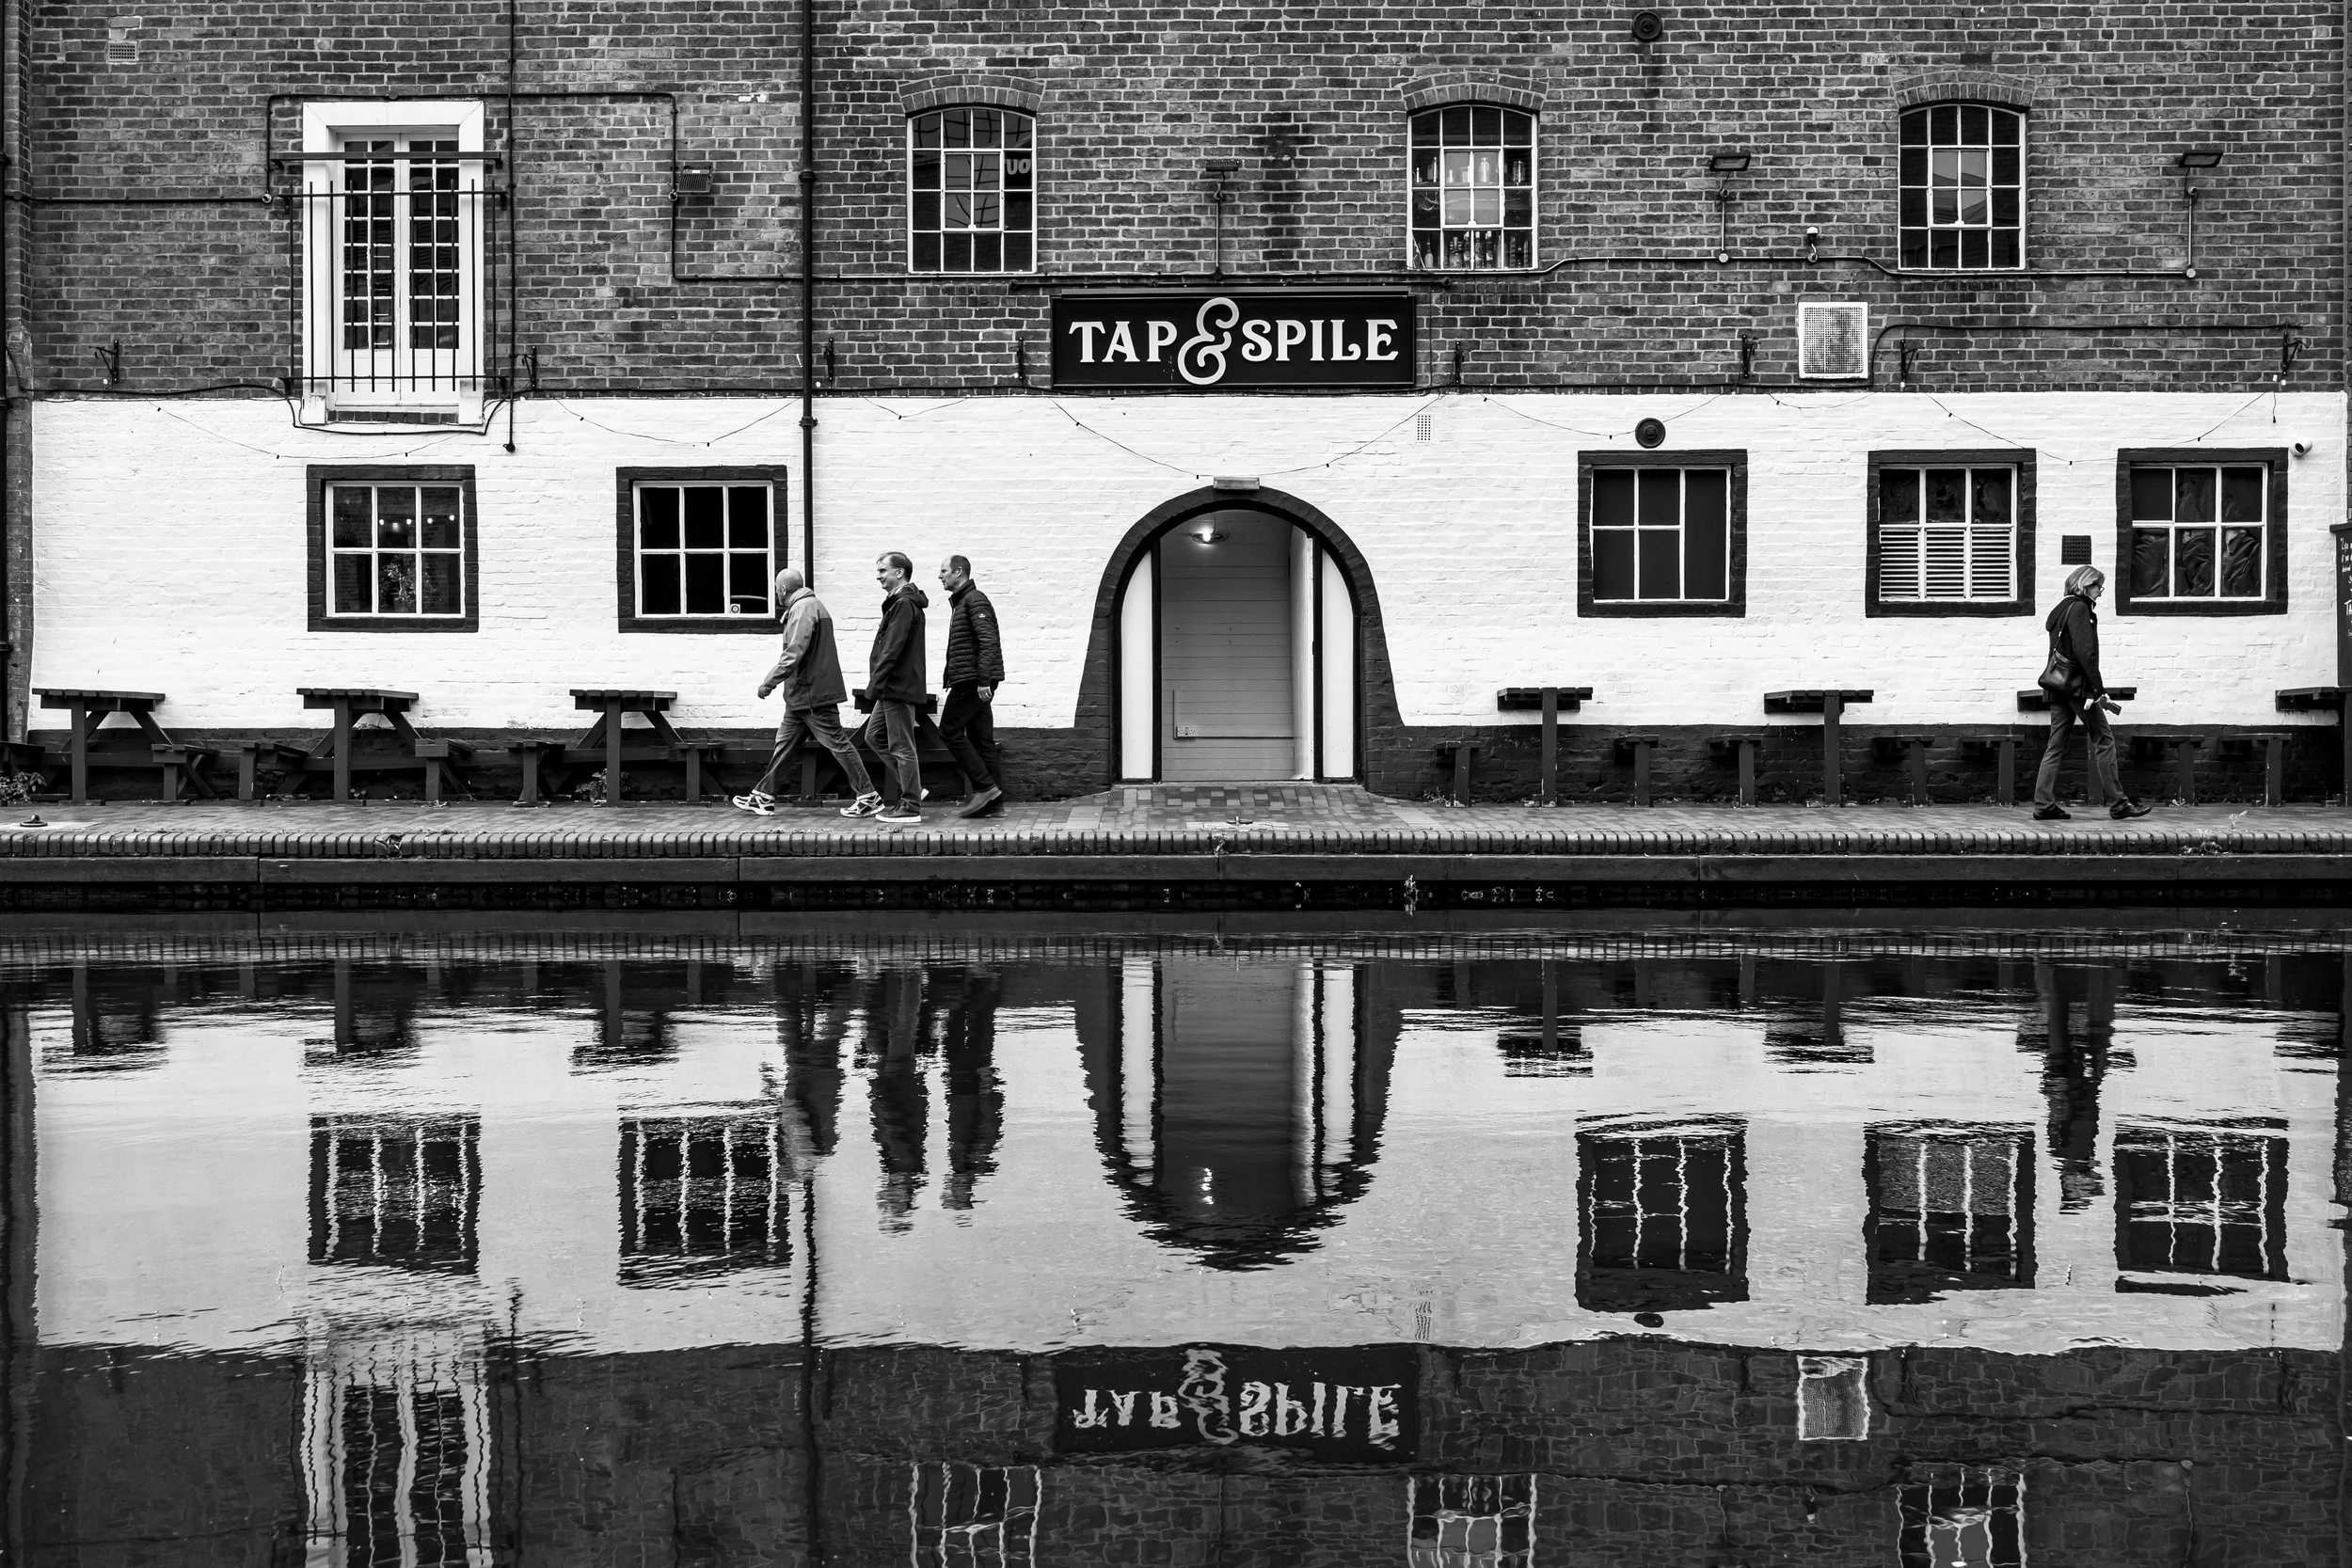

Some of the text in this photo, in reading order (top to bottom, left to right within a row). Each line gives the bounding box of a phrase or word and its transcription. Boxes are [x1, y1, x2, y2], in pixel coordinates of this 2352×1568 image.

[1069, 297, 1399, 385] TAP & SPILE
